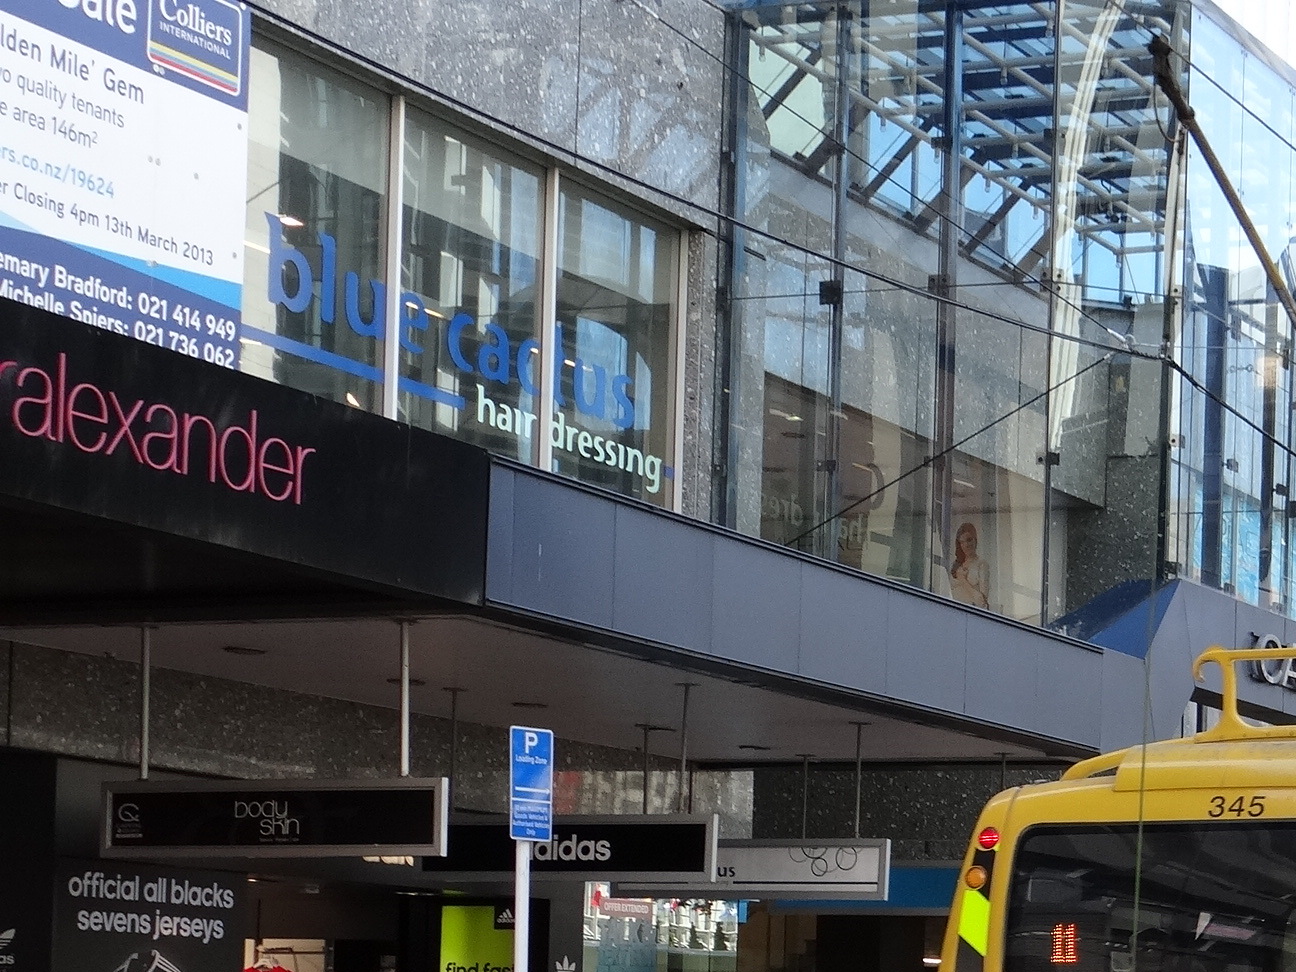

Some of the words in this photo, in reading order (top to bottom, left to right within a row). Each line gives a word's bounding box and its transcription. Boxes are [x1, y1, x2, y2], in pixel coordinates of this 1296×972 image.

[58, 0, 137, 34] ale
[160, 0, 232, 47] Colliers
[160, 21, 231, 60] INTERNATIONAL
[17, 74, 67, 110] quality
[71, 92, 125, 128] tenants
[103, 68, 145, 104] Gem
[13, 106, 46, 131] area
[0, 145, 115, 198] rs.co.nz/19624
[14, 182, 65, 219] Closing
[70, 202, 99, 230] 4pm
[105, 214, 133, 238] 13th
[138, 223, 178, 254] March
[182, 241, 214, 267] 2013
[54, 264, 133, 311] Bradford:
[138, 292, 168, 321] 021
[173, 304, 200, 332] 414
[206, 315, 236, 342] 949
[265, 211, 429, 355] blue
[448, 311, 635, 429] cactus
[134, 321, 163, 347] 021
[170, 331, 199, 359] 736
[204, 343, 235, 370] 062
[525, 731, 539, 754] P
[234, 800, 288, 819] body
[1208, 796, 1266, 818] 345
[260, 818, 300, 836] skin
[530, 834, 611, 861] didas
[68, 871, 140, 901] official
[143, 877, 167, 903] all
[171, 878, 235, 909] blacks
[603, 902, 621, 912] OFFER
[621, 903, 649, 914] EXTENDED
[77, 909, 151, 934] sevens
[152, 909, 225, 944] jerseys
[1050, 923, 1077, 963] 11
